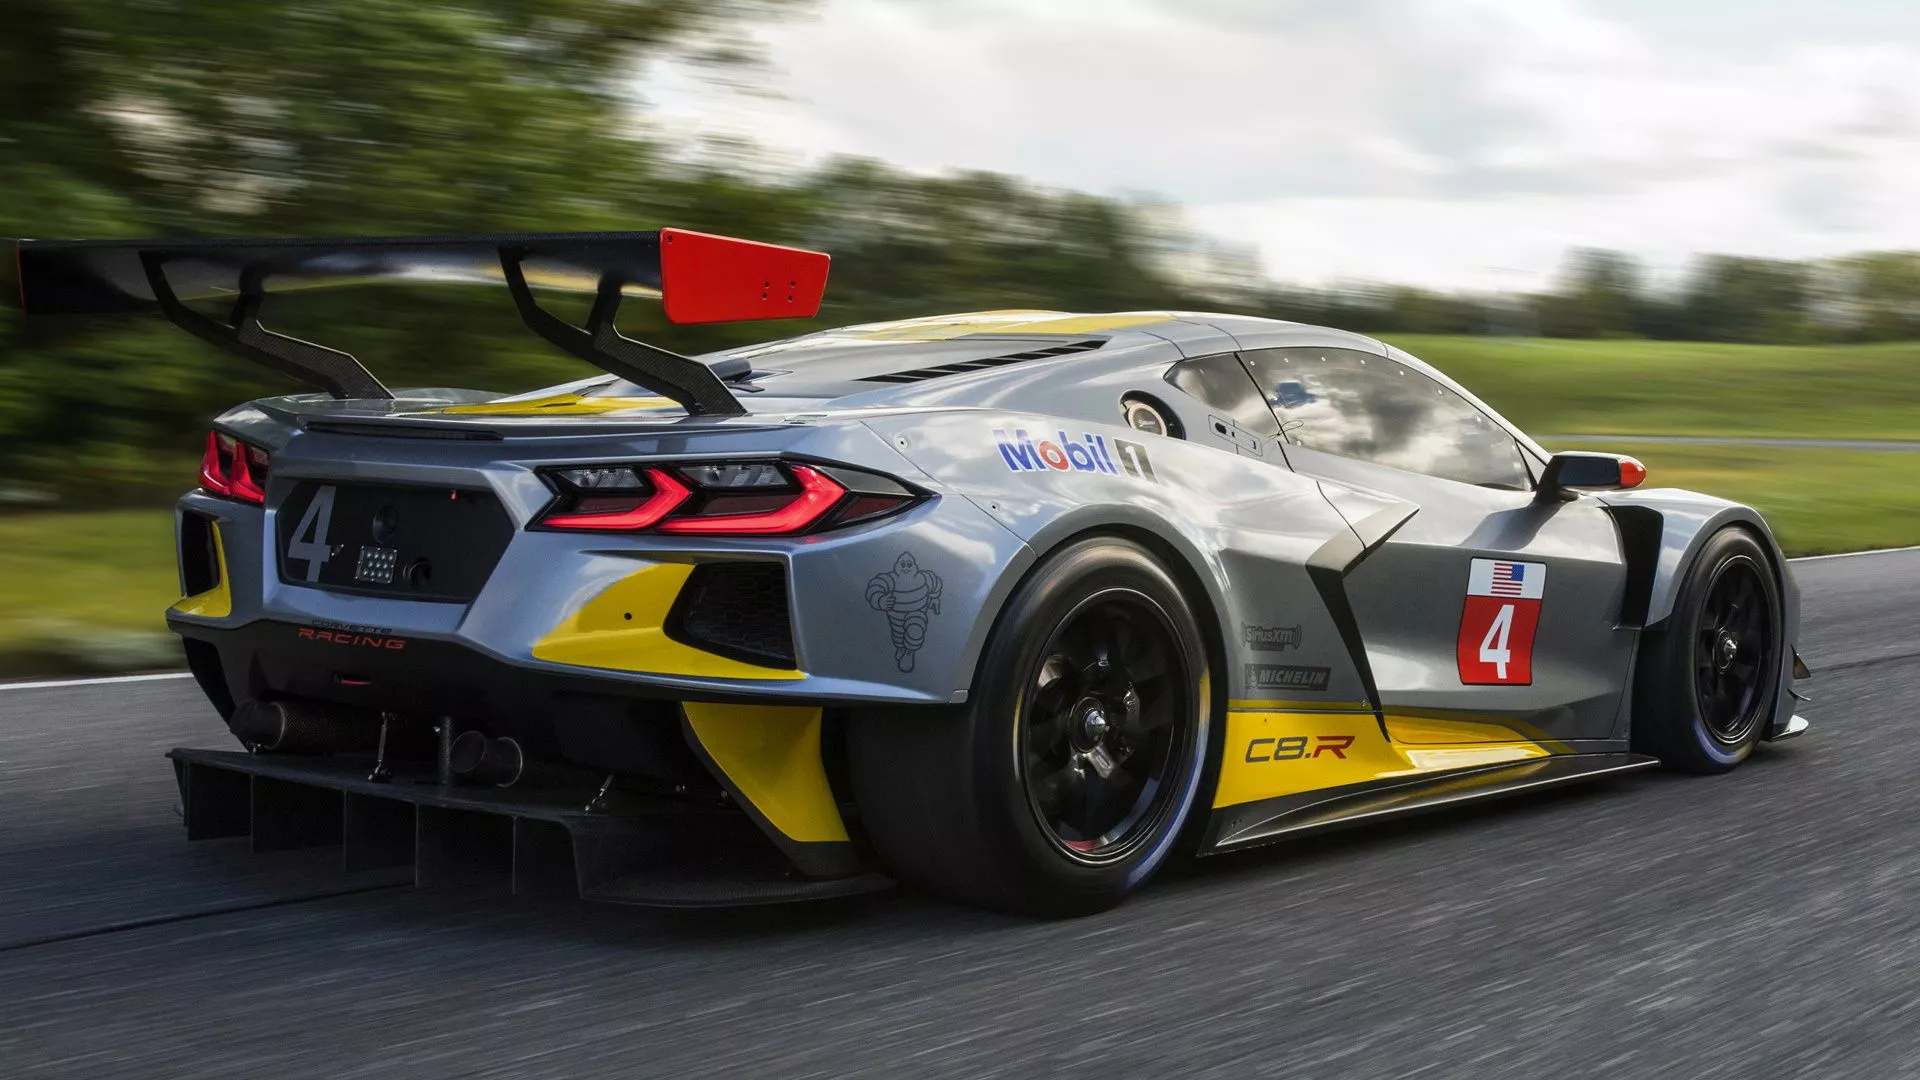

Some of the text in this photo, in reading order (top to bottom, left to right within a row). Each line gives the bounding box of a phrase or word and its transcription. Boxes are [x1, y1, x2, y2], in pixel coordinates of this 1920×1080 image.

[993, 429, 1151, 483] Mobil 1
[288, 485, 336, 582] 4
[298, 628, 406, 650] RACING
[1479, 604, 1515, 679] 4
[1259, 668, 1327, 685] MICHELIN
[1245, 735, 1356, 763] C8.R
